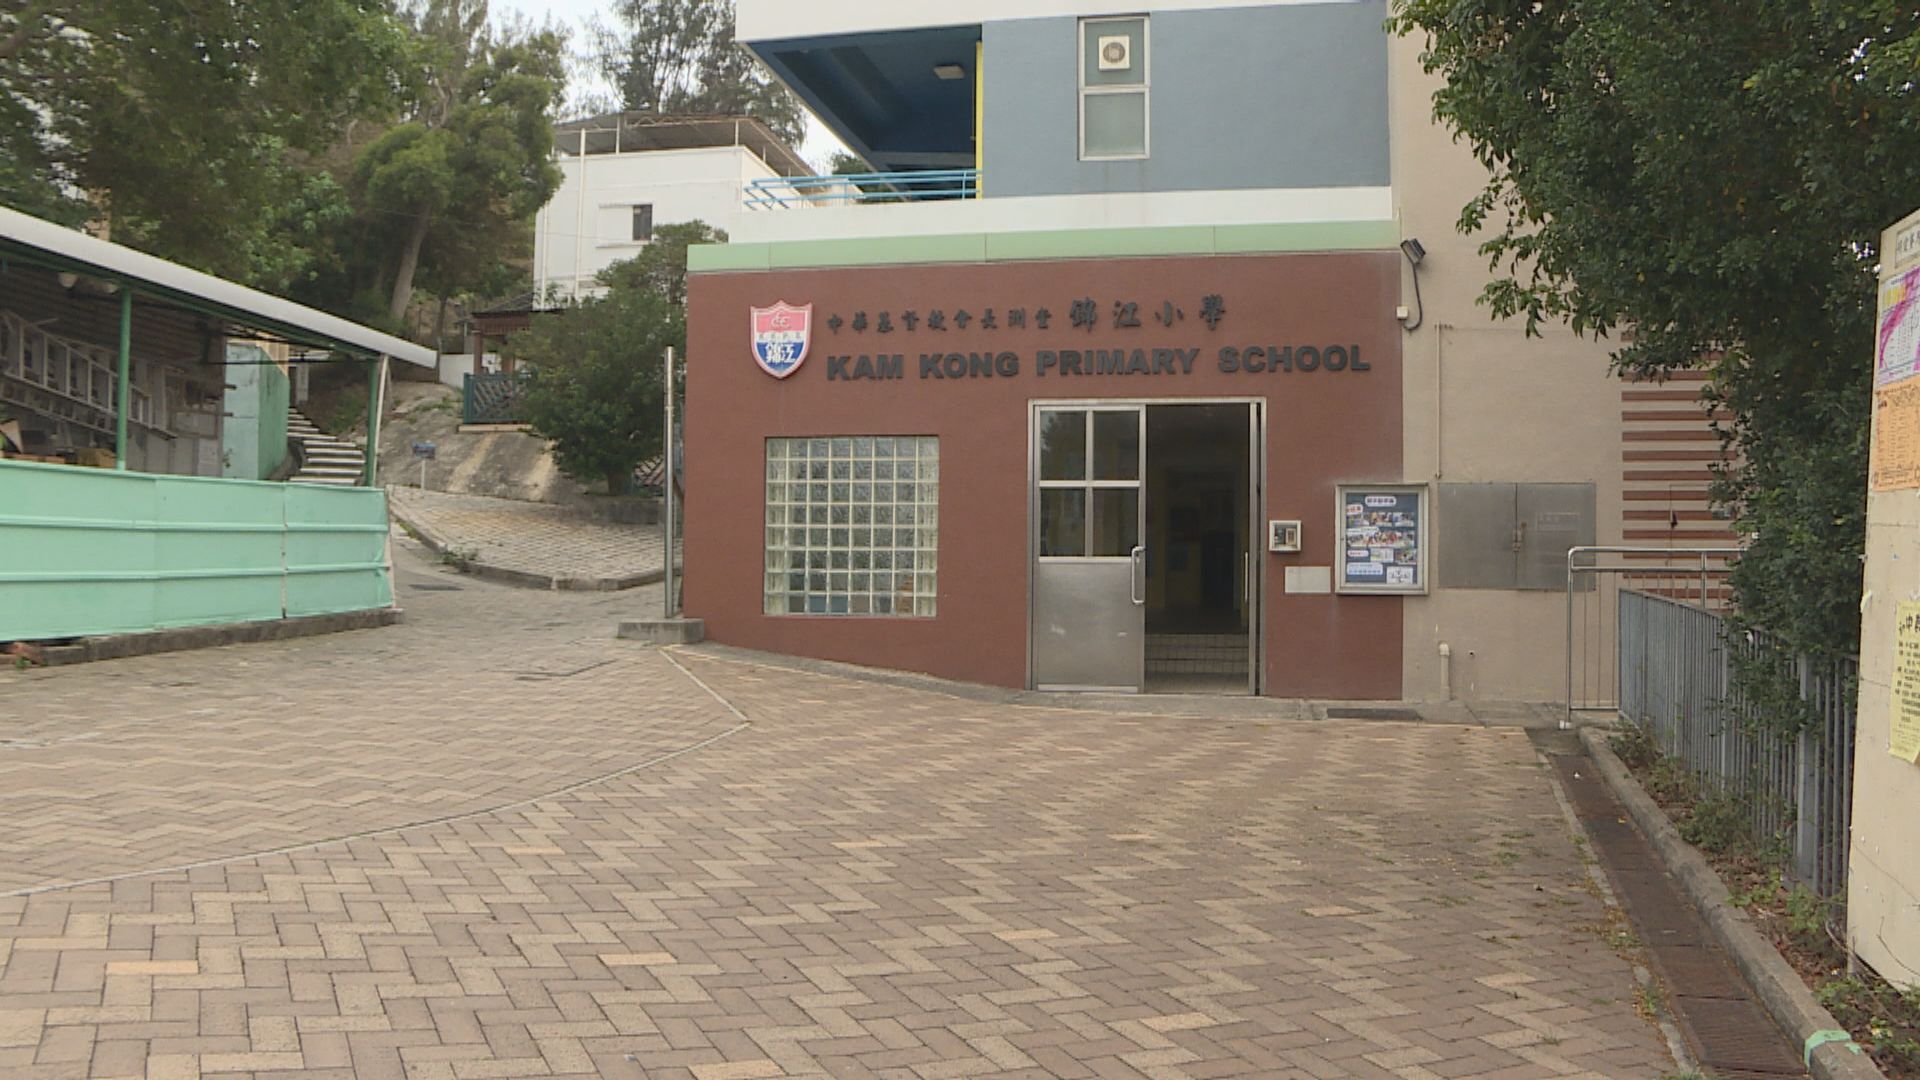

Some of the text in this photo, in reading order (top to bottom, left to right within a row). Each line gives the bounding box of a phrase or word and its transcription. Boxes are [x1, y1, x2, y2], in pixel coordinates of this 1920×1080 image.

[827, 345, 1371, 381] KAM KONG PRIMARY SCHOOL
